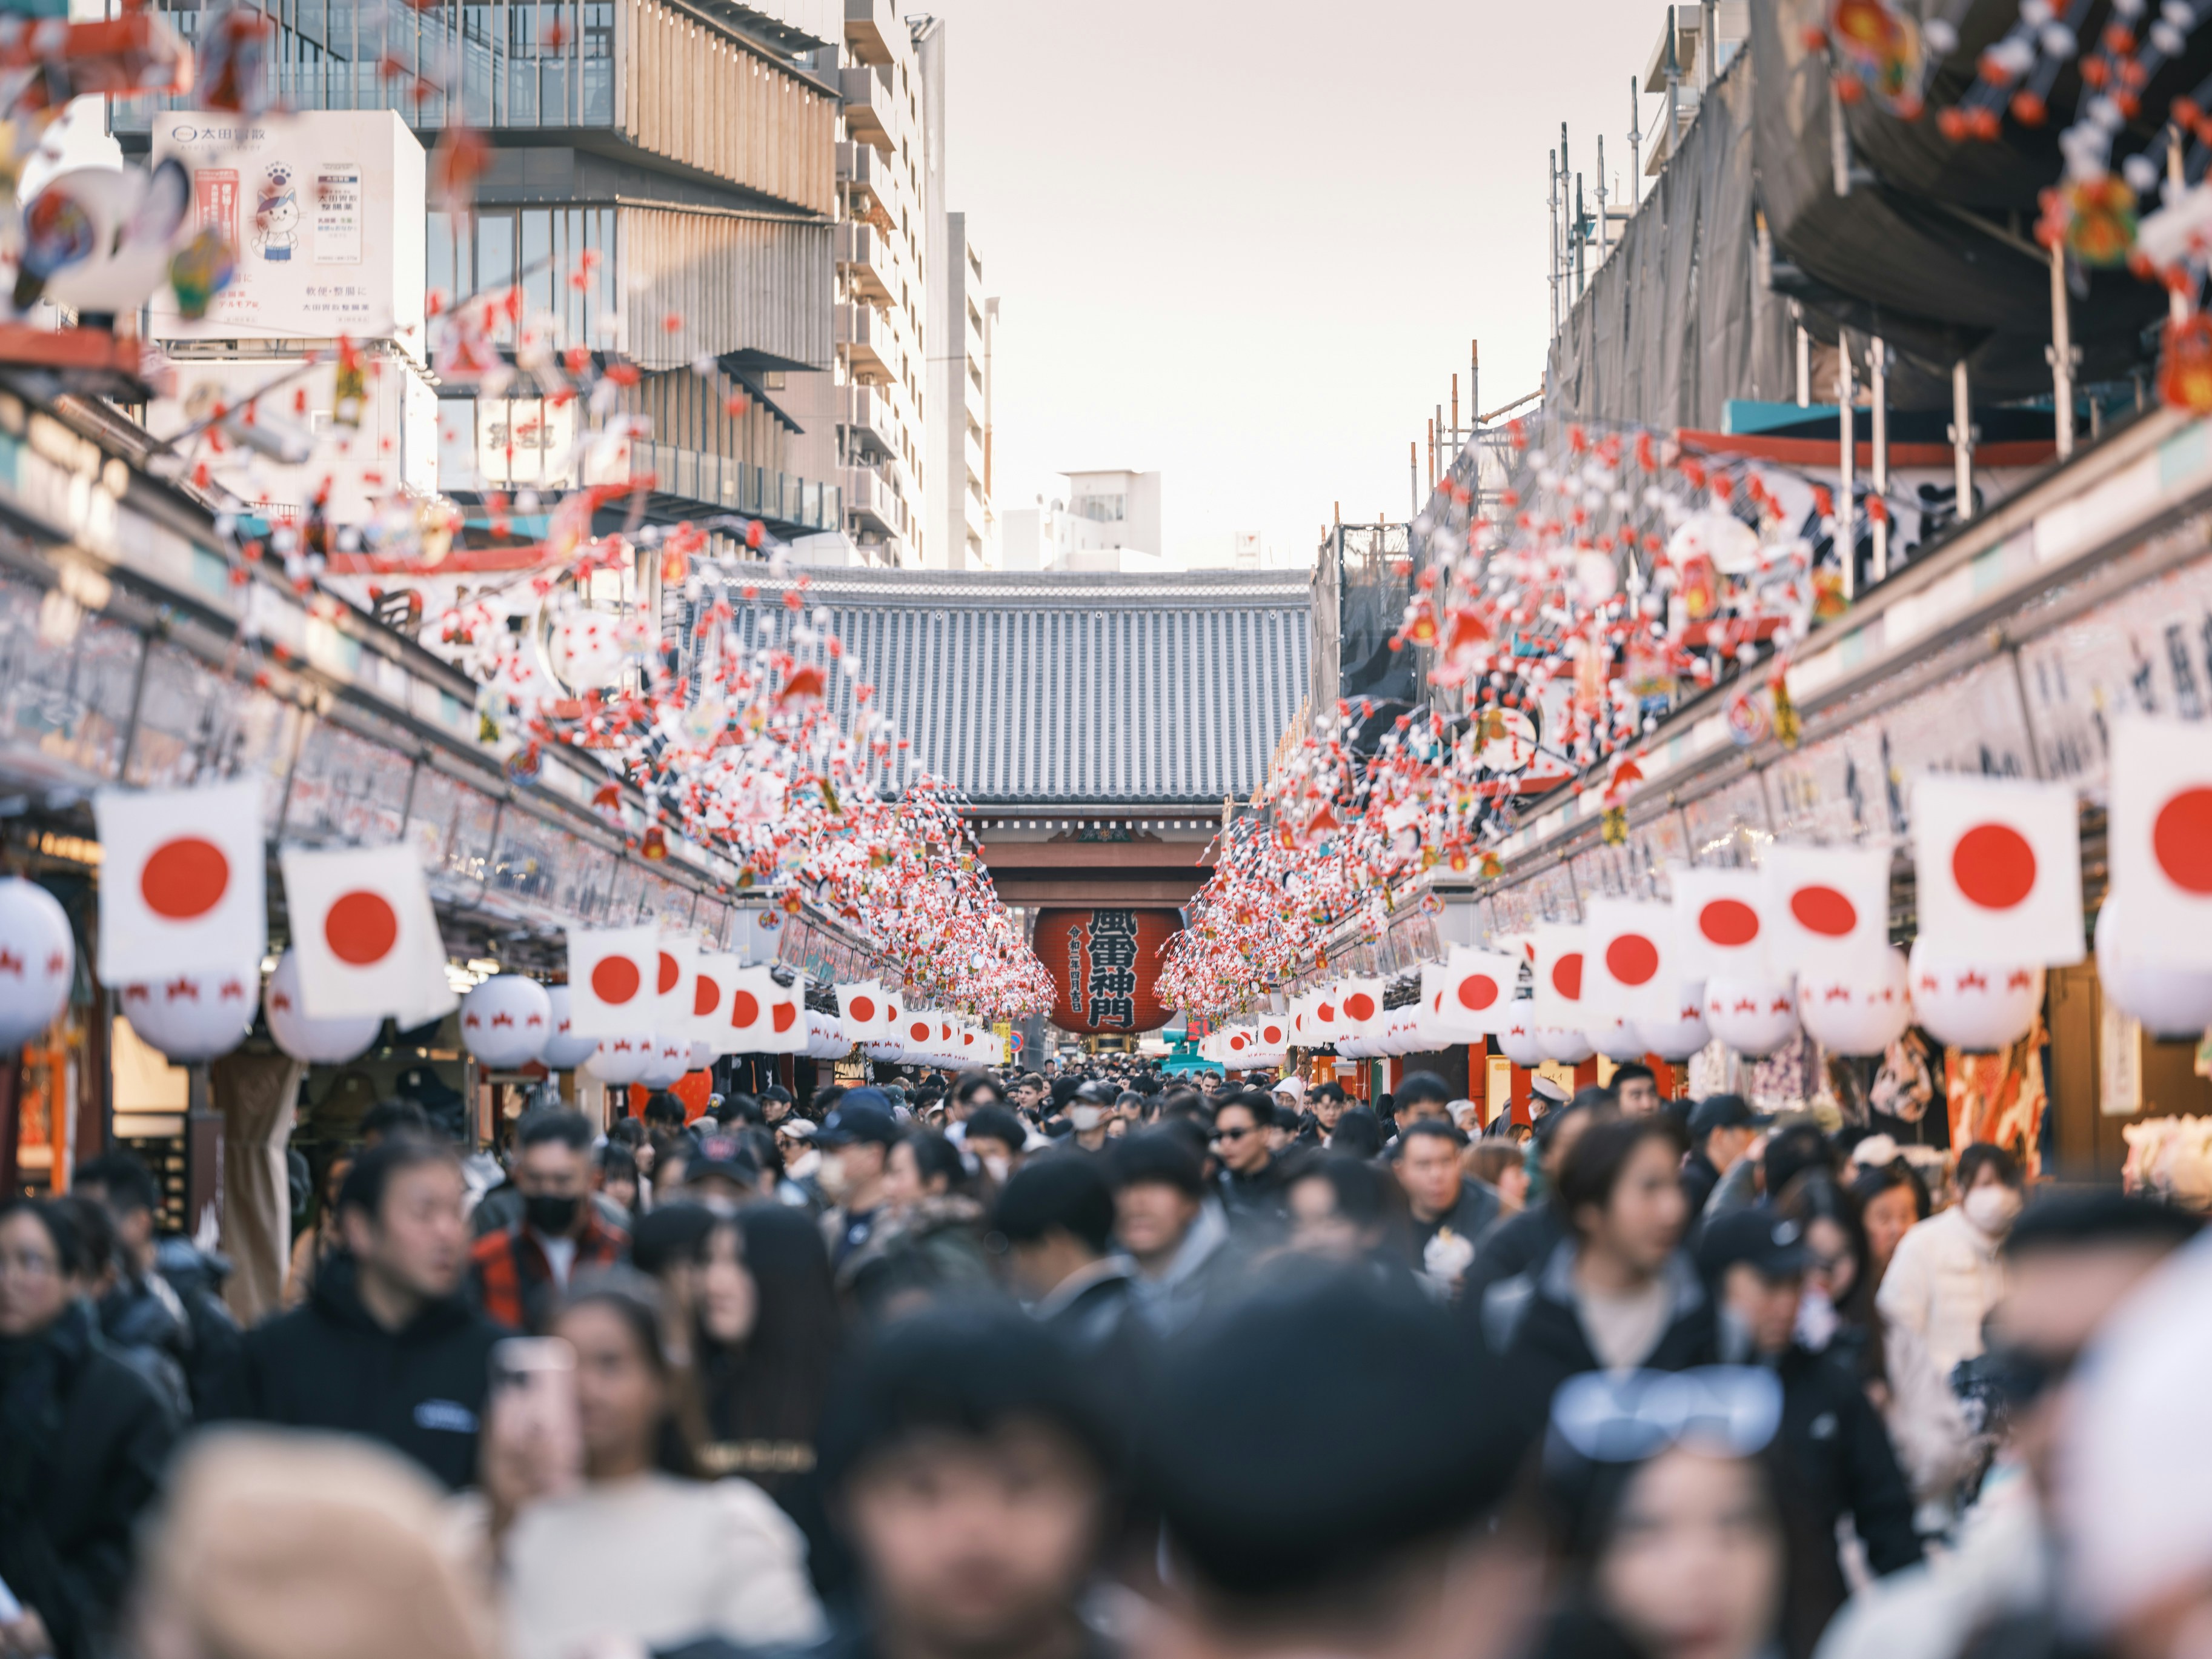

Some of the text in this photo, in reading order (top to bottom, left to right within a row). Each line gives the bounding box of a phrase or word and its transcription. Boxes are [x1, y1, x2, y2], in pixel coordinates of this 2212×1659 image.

[1068, 924, 1083, 1013] 令和二年四月吉日
[1087, 909, 1138, 1029] 風雷神門
